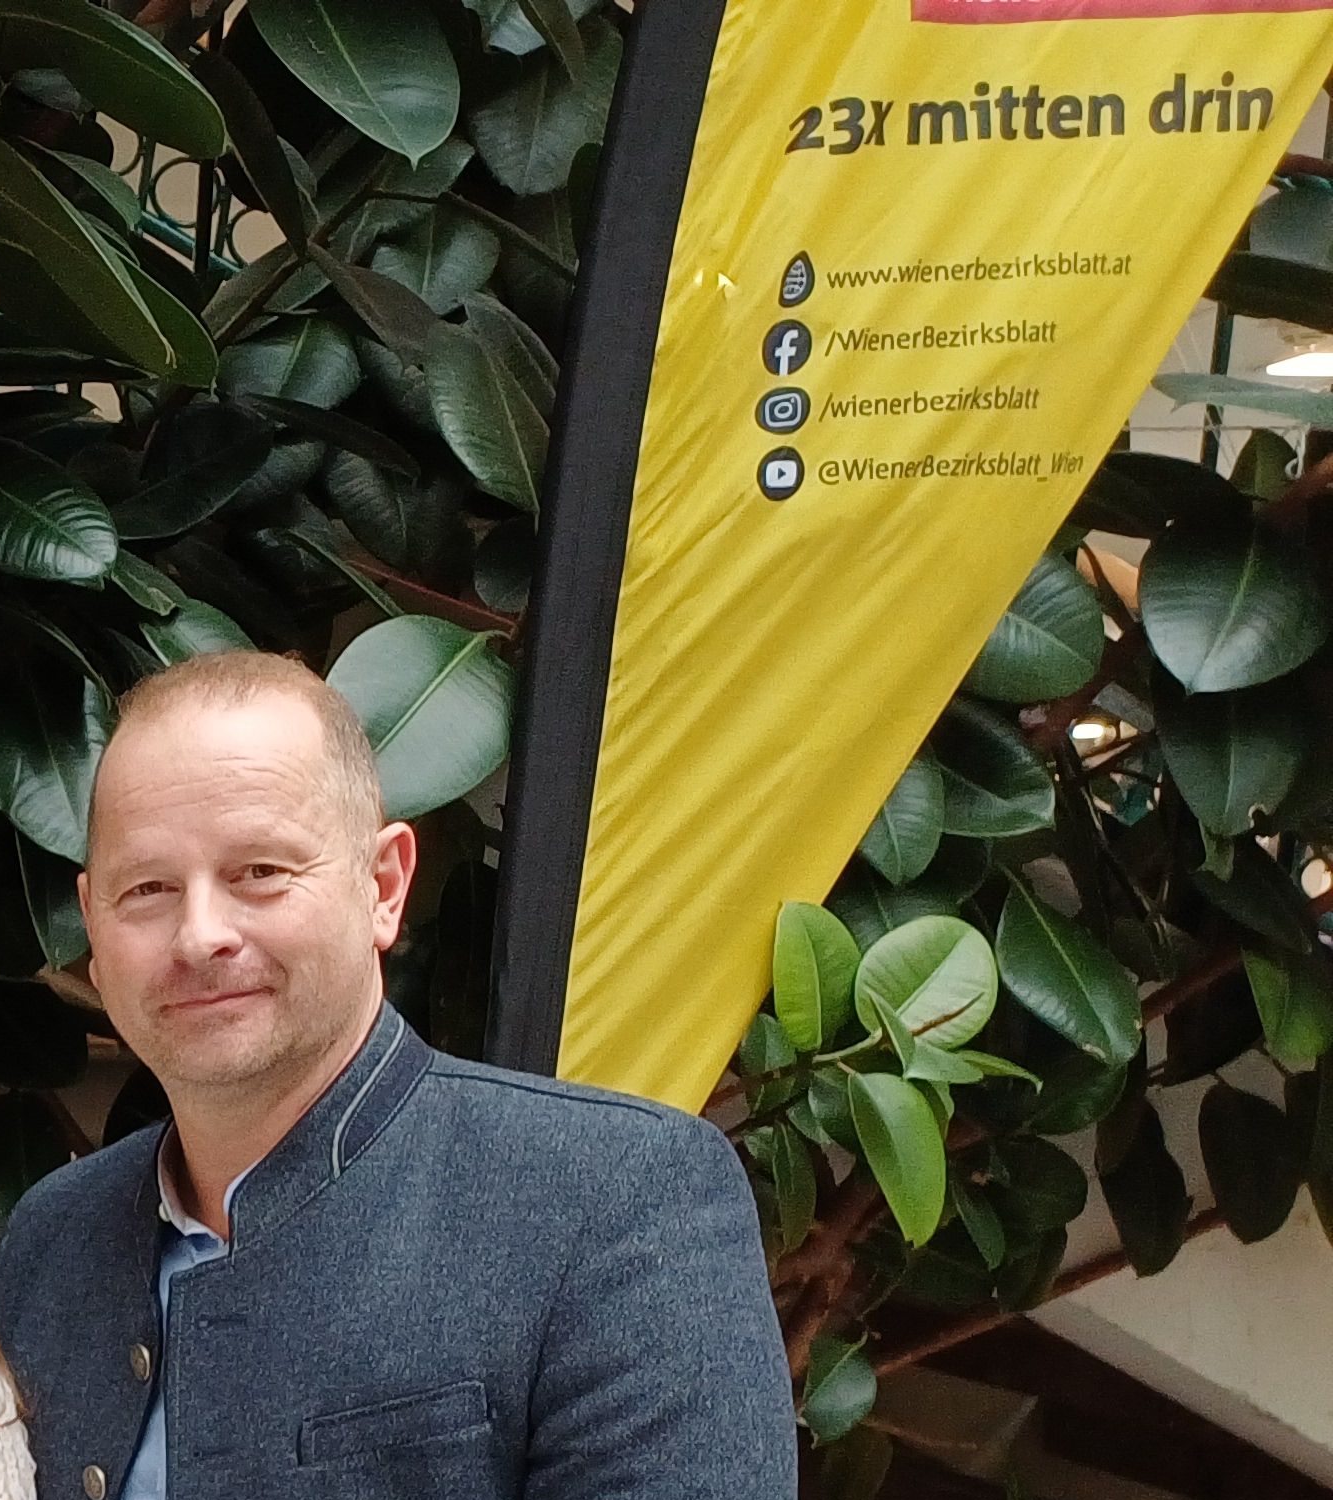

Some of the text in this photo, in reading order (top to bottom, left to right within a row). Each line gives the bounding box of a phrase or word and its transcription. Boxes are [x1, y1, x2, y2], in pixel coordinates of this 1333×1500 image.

[907, 81, 1125, 146] mitten
[1149, 70, 1274, 134] drin
[827, 251, 1132, 289] www.wienerbezirksblatt.at
[824, 319, 1058, 357] /WienerBezirksblatt
[818, 385, 1040, 423] /wienerbezirksblatt
